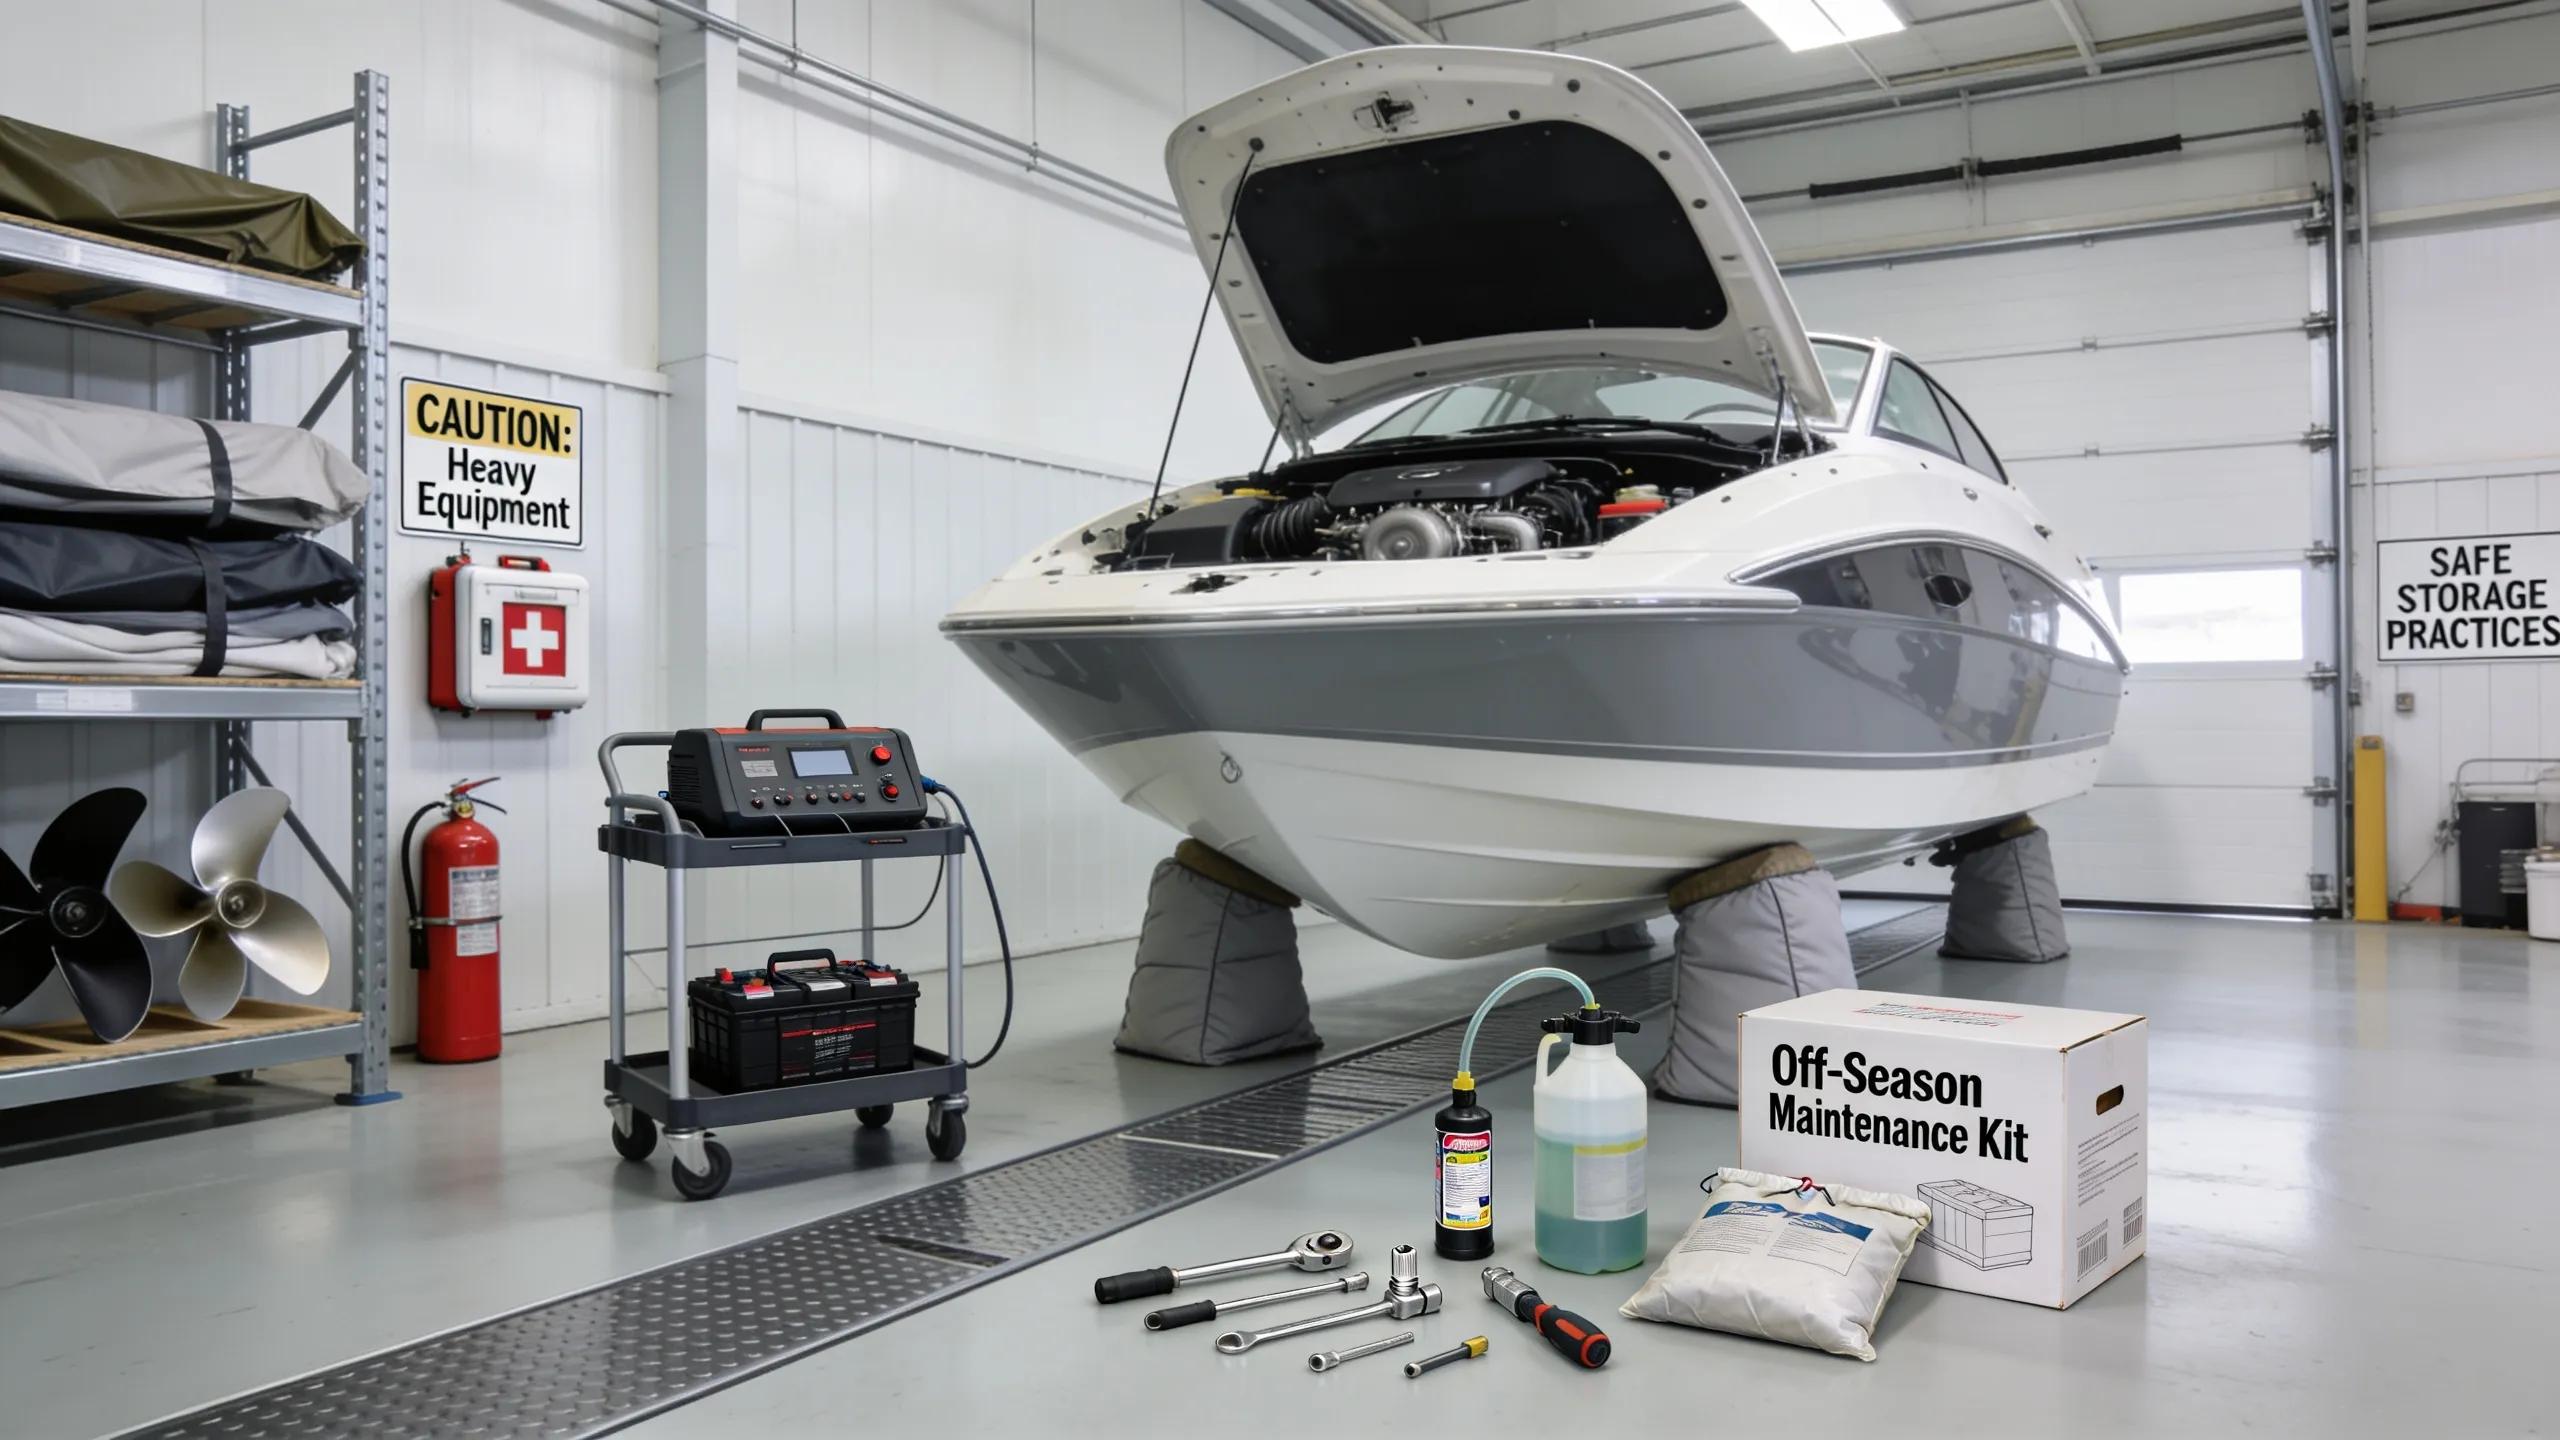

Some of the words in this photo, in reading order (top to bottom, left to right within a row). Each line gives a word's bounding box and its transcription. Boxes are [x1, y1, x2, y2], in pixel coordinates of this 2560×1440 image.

[416, 393, 571, 453] CAUTION:
[448, 447, 536, 495] Heavy
[418, 481, 570, 530] Equipment
[2430, 543, 2512, 577] SAFE
[2398, 579, 2548, 614] STORAGE
[2387, 615, 2560, 650] PRACTICES
[1772, 1043, 1982, 1108] Off-Season
[1769, 1092, 1969, 1155] Maintenance
[1978, 1116, 2029, 1163] Kit
